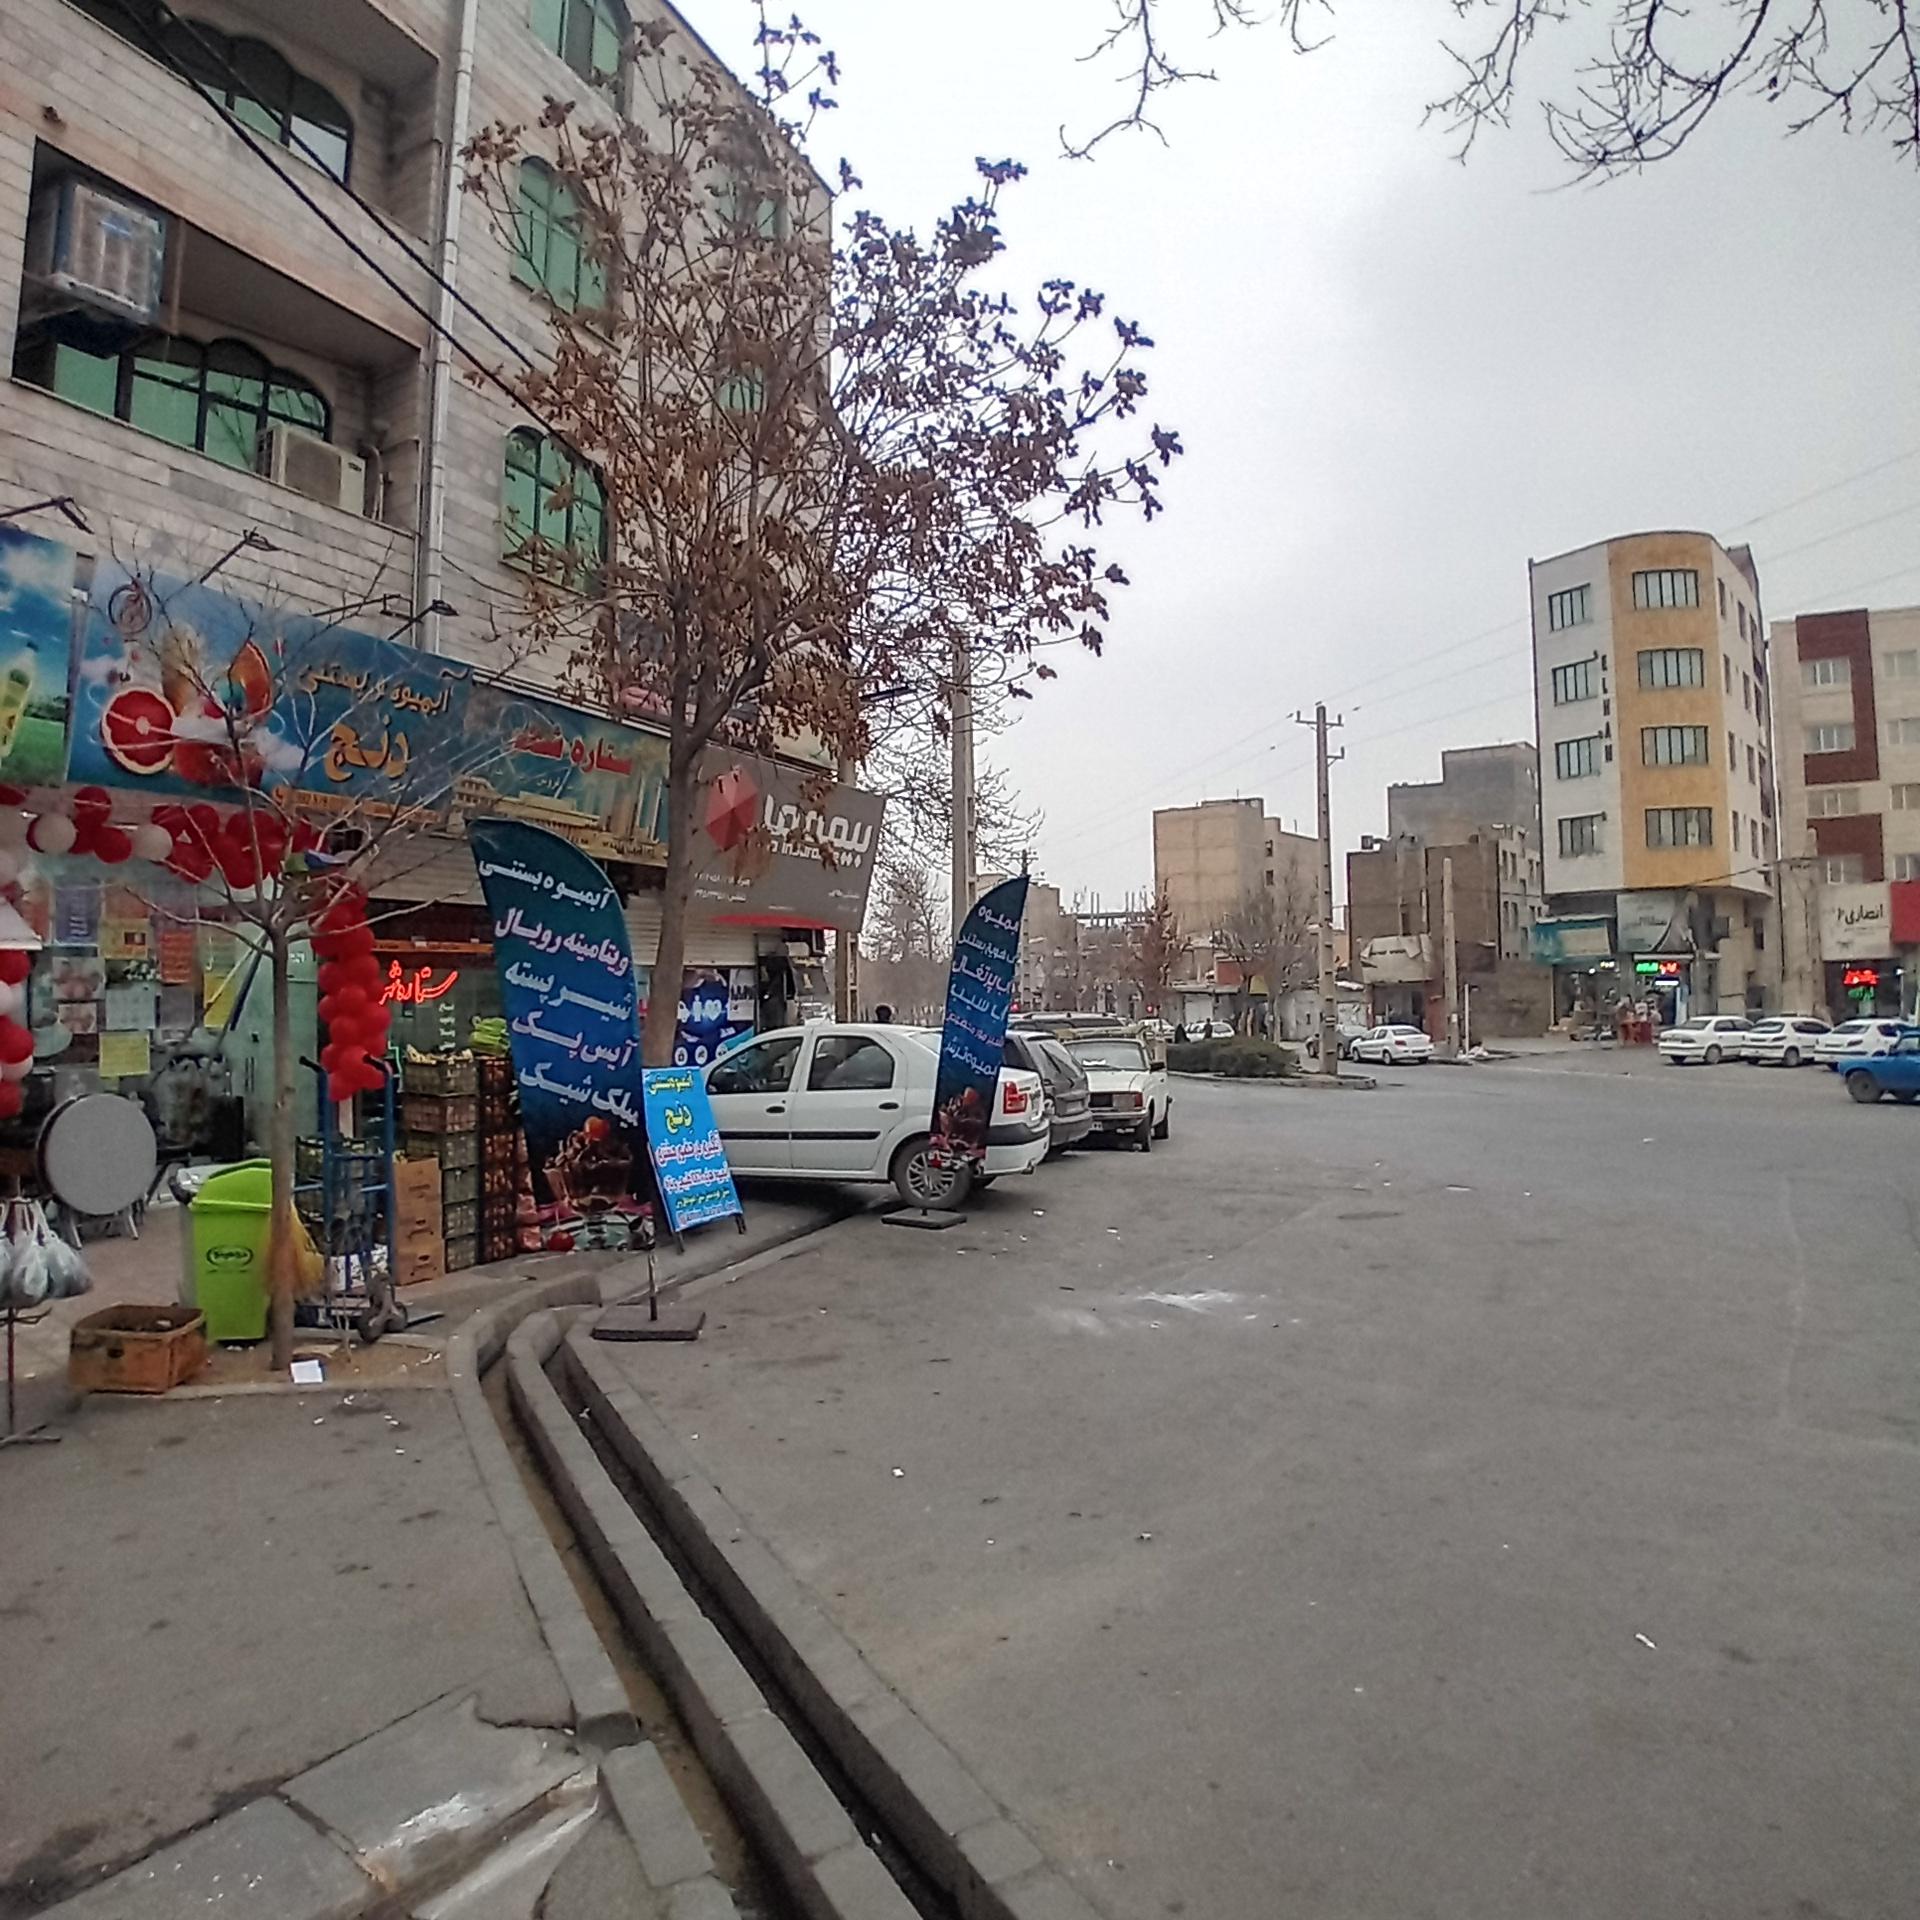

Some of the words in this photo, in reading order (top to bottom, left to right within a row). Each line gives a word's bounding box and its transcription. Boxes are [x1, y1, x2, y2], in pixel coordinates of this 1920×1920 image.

[479, 859, 542, 892] بستنی
[543, 876, 615, 912] آبمیوه
[494, 906, 561, 955] رویال
[563, 932, 630, 977] ویتامینه
[505, 960, 555, 1004] پسته
[952, 955, 997, 993] پرتغال
[547, 984, 633, 1022] شیر
[950, 983, 990, 1013] سیب
[511, 1010, 583, 1060] پک
[579, 1038, 638, 1071] آیس
[519, 1062, 592, 1106] شیک
